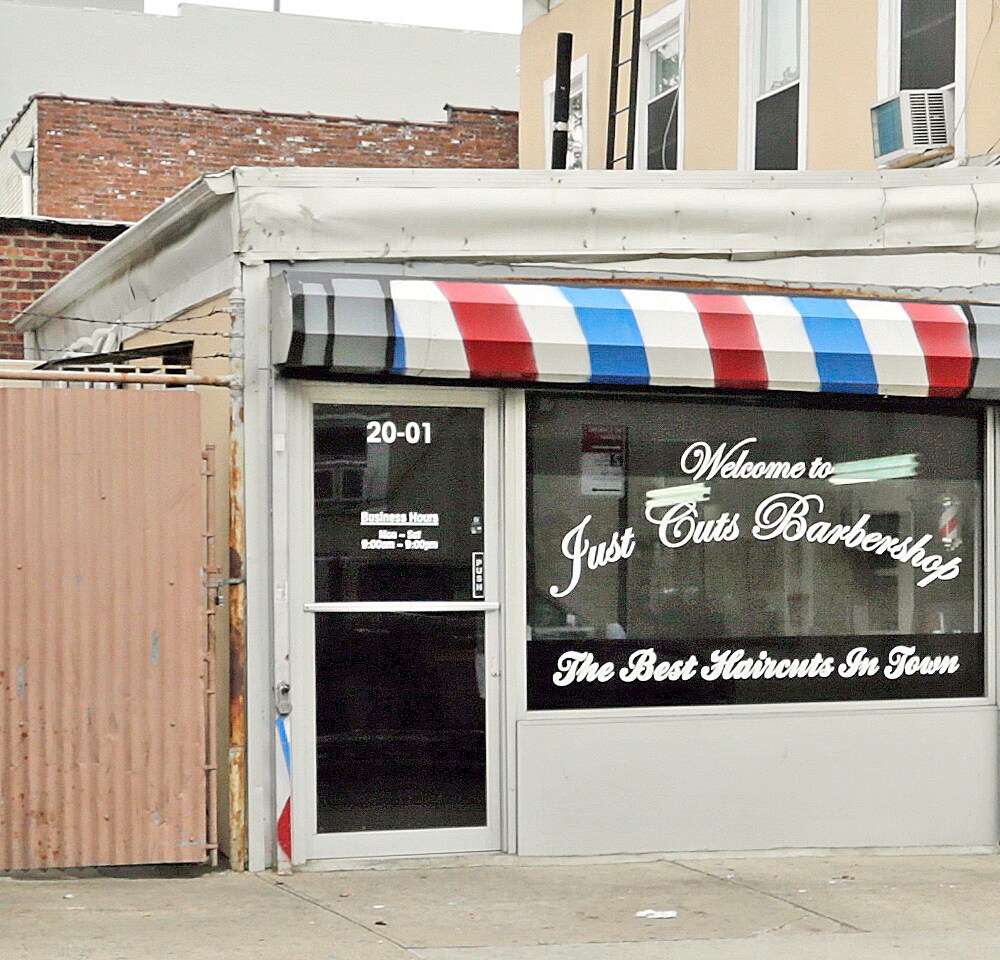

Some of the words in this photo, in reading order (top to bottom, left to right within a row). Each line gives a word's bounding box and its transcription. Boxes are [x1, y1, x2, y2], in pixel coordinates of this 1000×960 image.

[366, 420, 431, 444] 20-01
[680, 437, 806, 482] Welcome
[808, 454, 834, 480] to
[360, 511, 407, 523] Business
[408, 511, 439, 524] Hours
[549, 514, 636, 598] Just
[644, 492, 740, 549] Cuts
[751, 492, 963, 588] Barbershop
[552, 650, 616, 687] The
[618, 647, 699, 683] Best
[700, 648, 835, 681] Haircuts
[837, 646, 880, 678] In
[883, 645, 961, 680] Town
